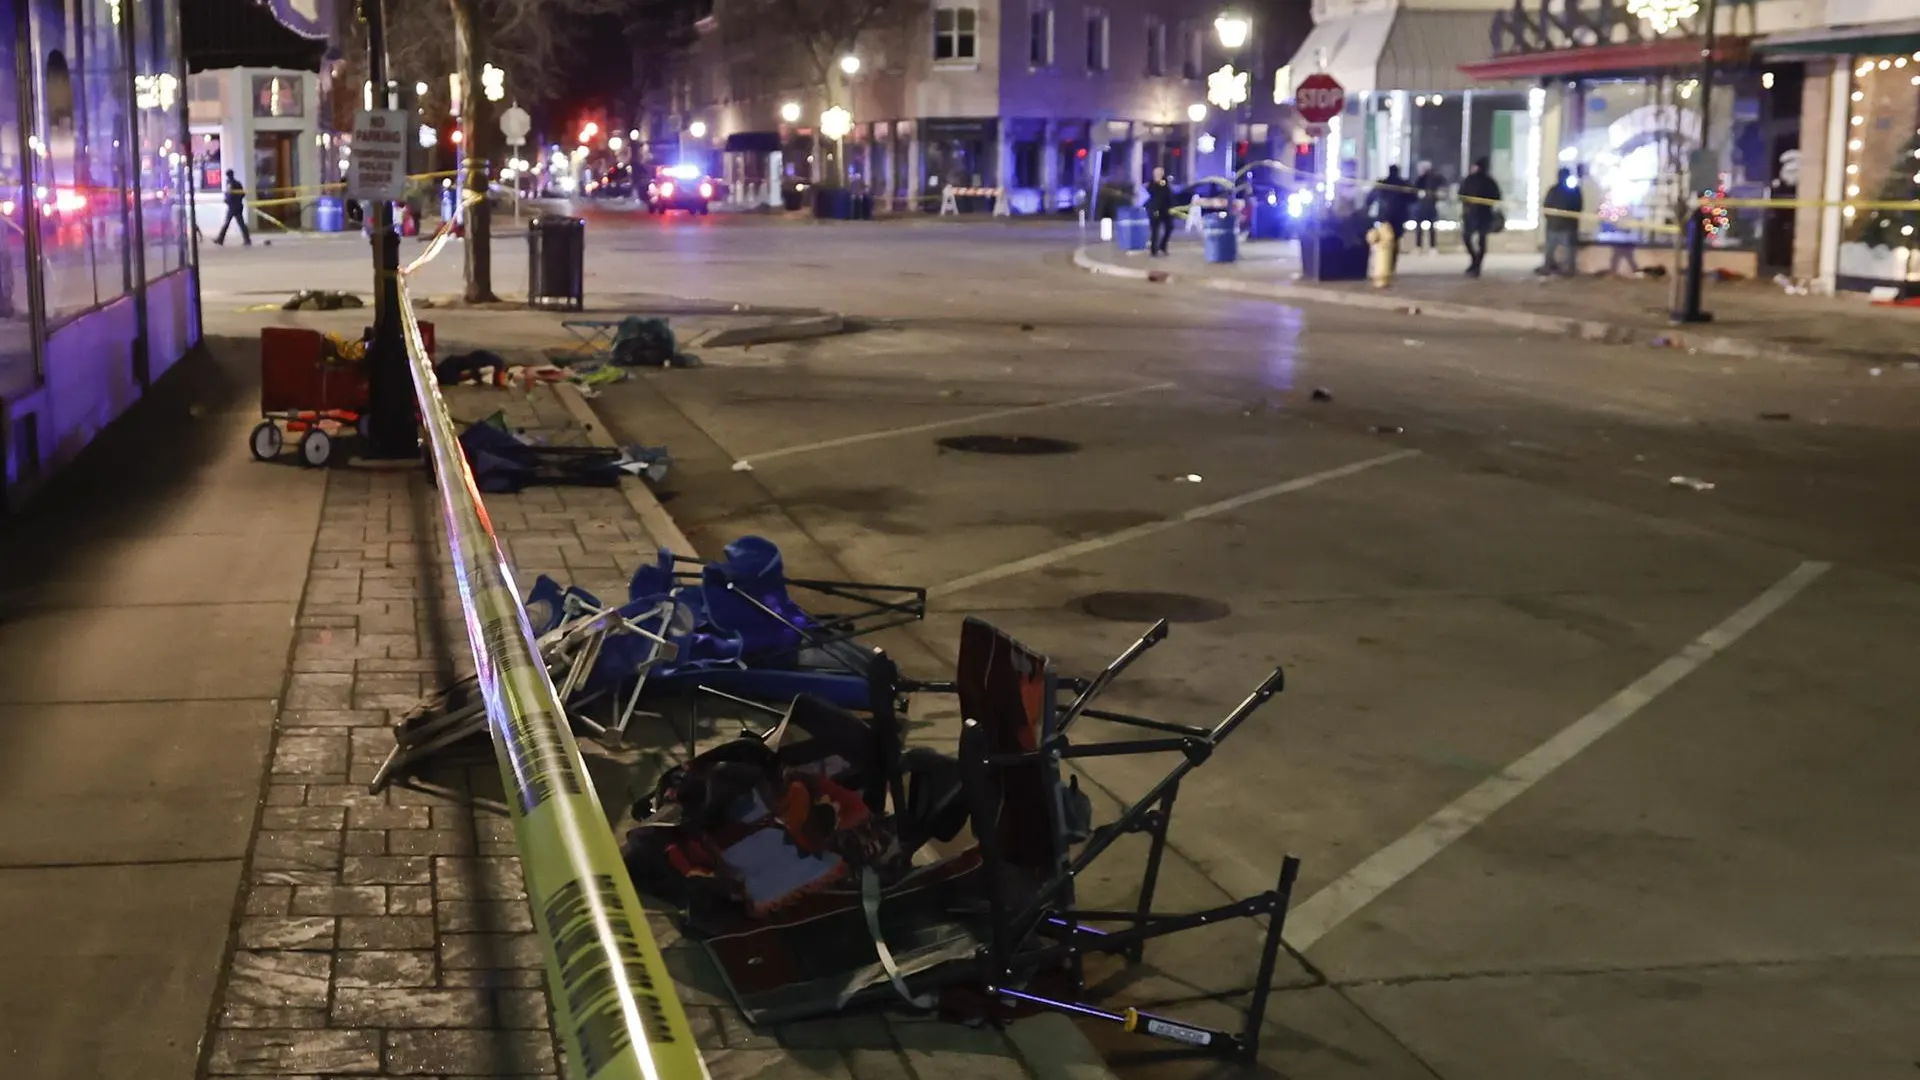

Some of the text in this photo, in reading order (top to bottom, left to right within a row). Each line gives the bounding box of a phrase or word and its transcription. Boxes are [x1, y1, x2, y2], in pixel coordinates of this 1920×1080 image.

[1298, 88, 1343, 108] STOP
[370, 116, 386, 129] NO
[356, 130, 400, 143] PARKING
[358, 161, 393, 172] POLICE
